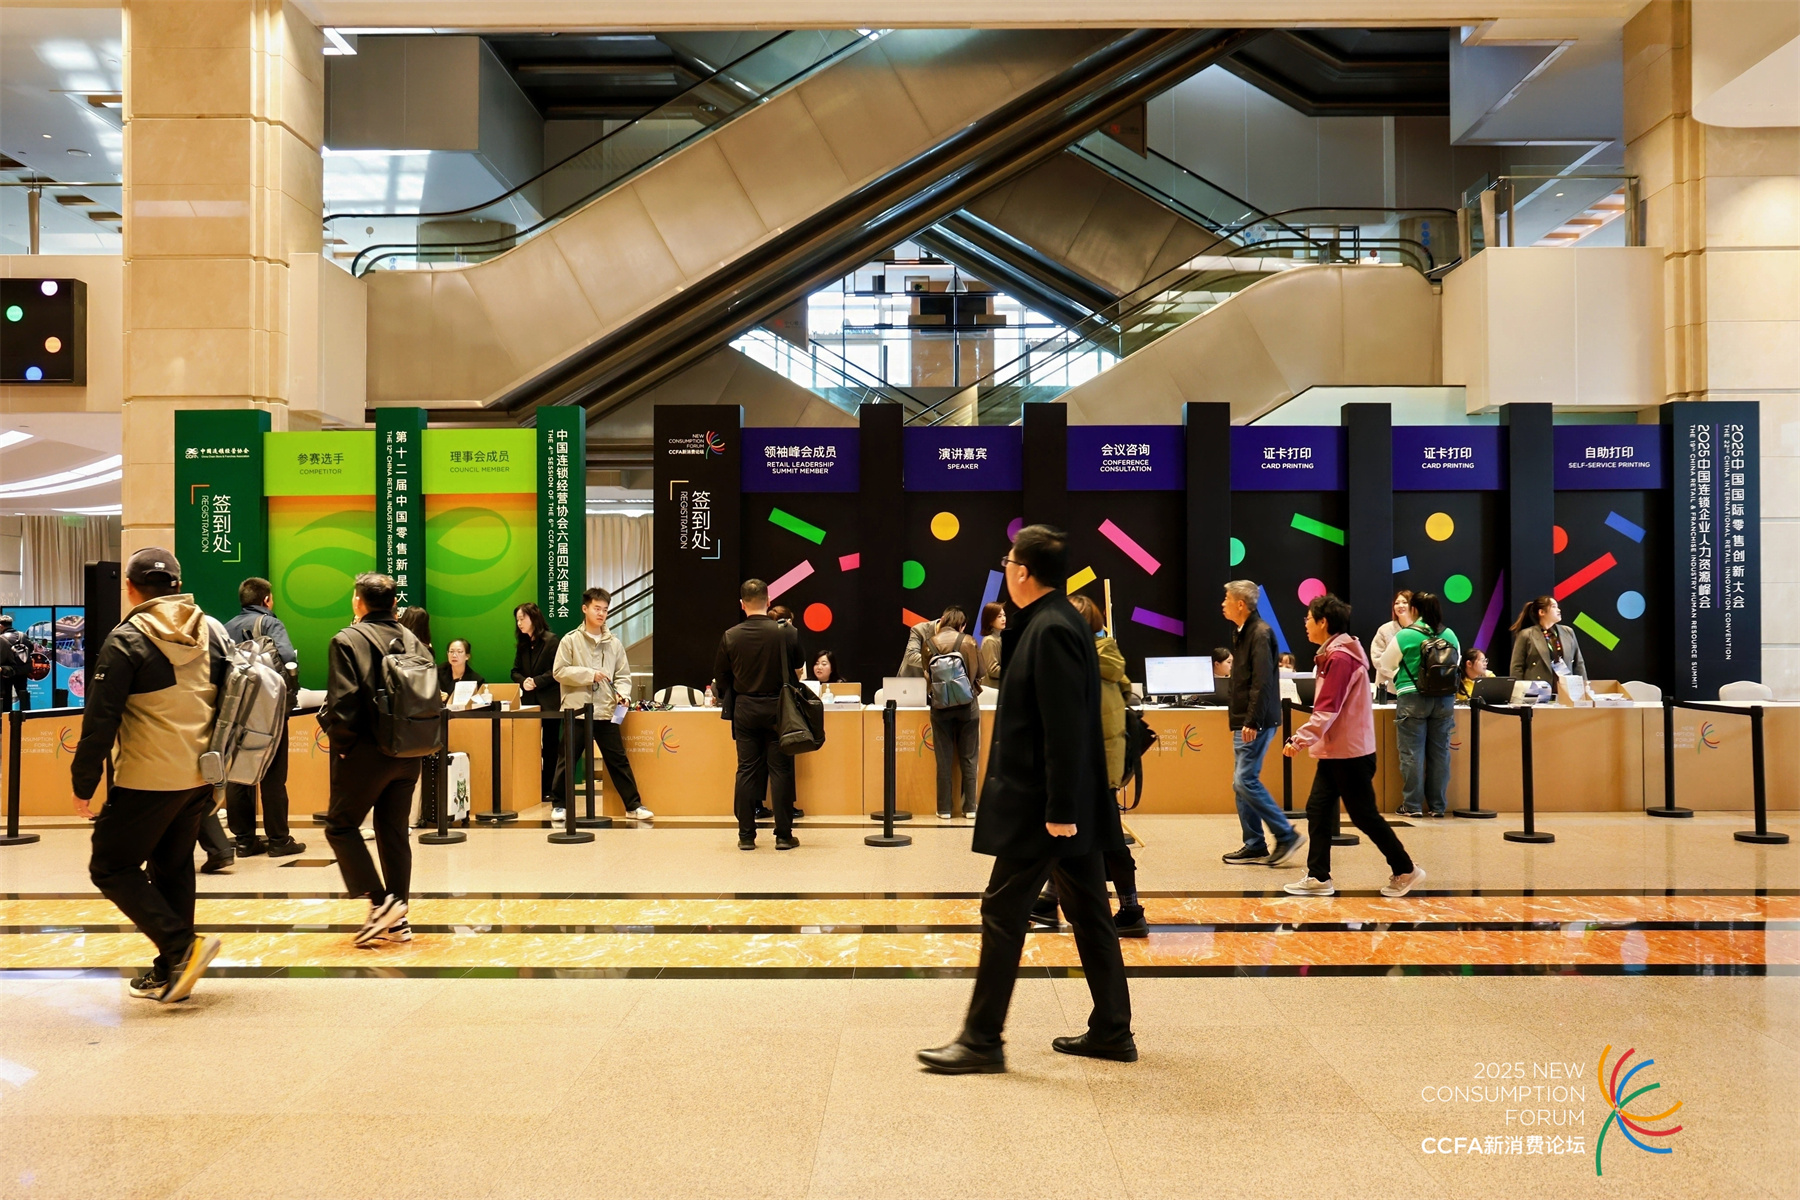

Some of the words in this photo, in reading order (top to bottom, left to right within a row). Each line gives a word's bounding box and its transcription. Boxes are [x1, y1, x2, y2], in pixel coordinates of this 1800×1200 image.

[764, 446, 836, 458] 领袖峰会成员
[938, 448, 987, 460] 演讲嘉宾
[1101, 443, 1150, 456] 会议咨询
[1263, 447, 1312, 459] 证卡打印
[1424, 447, 1472, 459] 证卡打印
[1585, 446, 1634, 458] 自助打印
[297, 453, 344, 465] 参赛选手
[450, 450, 510, 462] 理事会成员
[548, 490, 554, 500] OF
[680, 491, 688, 550] REGISTRATION
[692, 490, 711, 550] 签到处
[1698, 424, 1710, 608] 2025中国连锁企业人力资源峰会
[1731, 424, 1744, 608] 2025中国国际零售创新大会
[212, 494, 231, 553] 签到处
[556, 429, 569, 618] 中国连锁经营协会六届四次理事会
